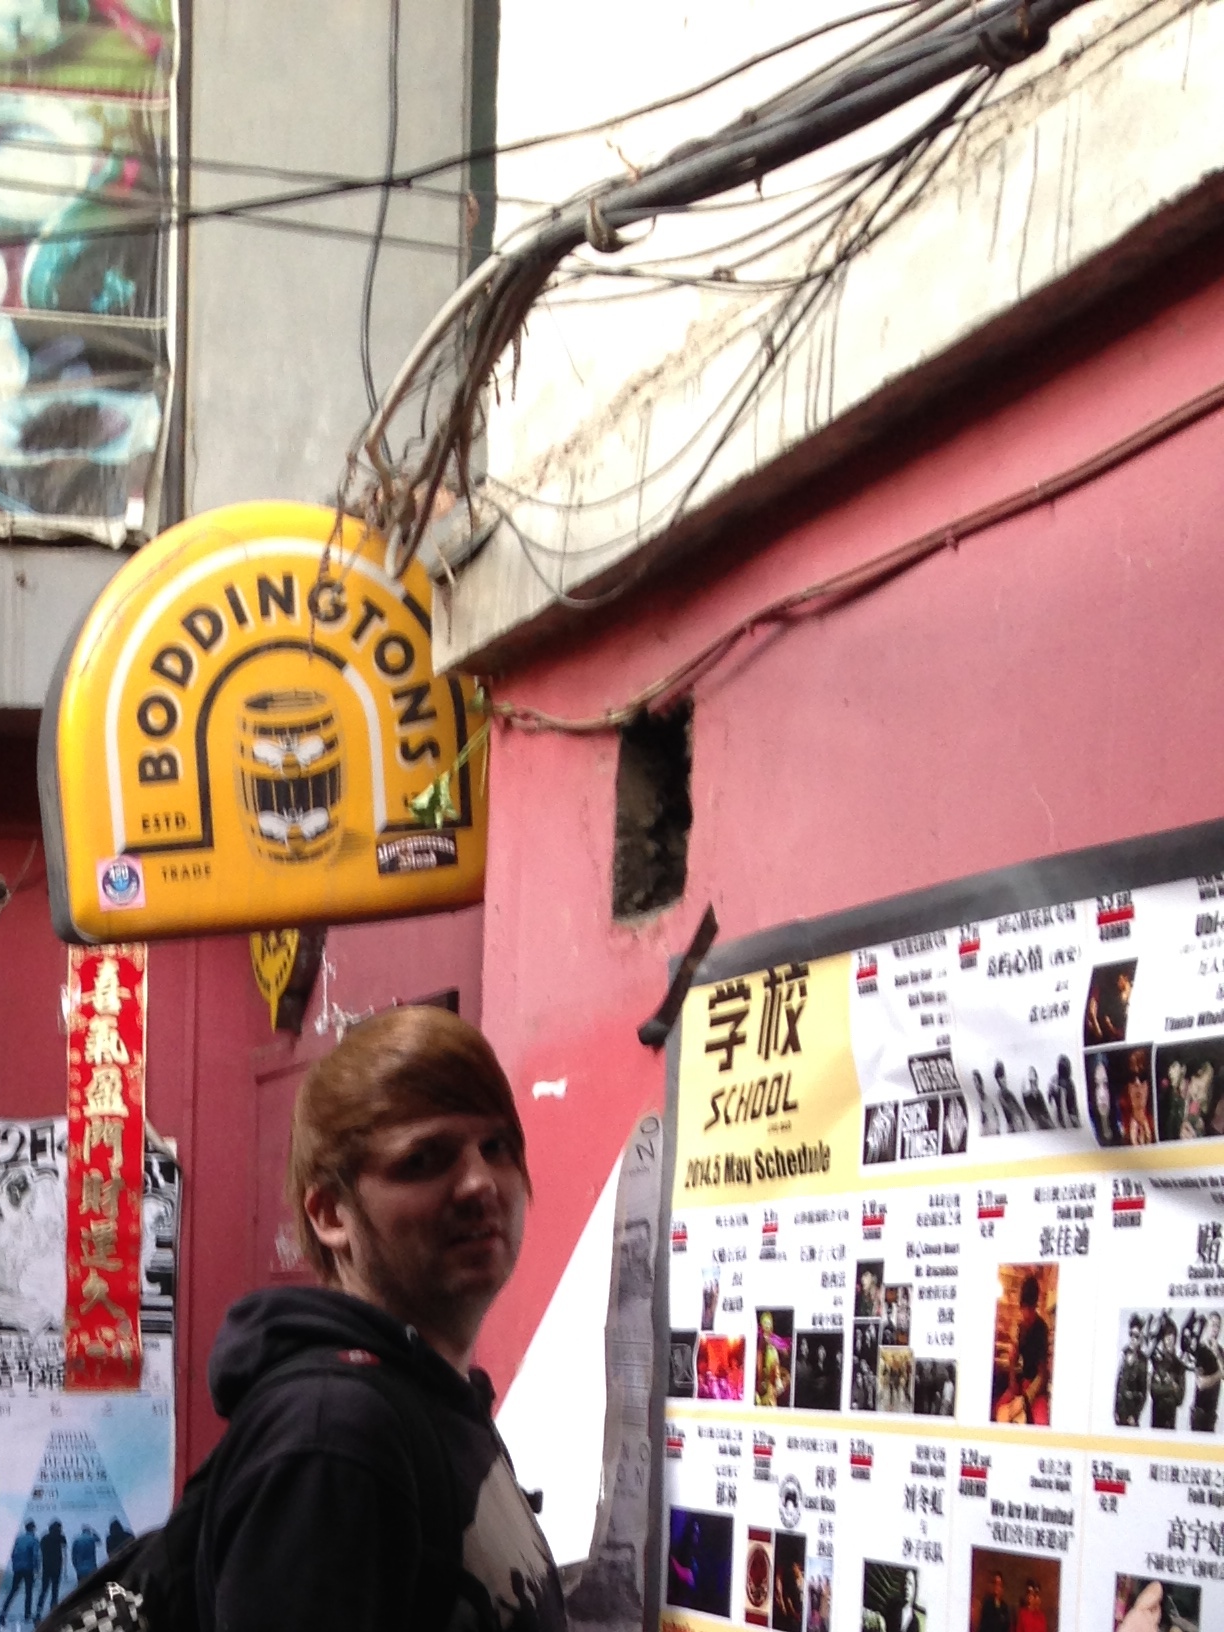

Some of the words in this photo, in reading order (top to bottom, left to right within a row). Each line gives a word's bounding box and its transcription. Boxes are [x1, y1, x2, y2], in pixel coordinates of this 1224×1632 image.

[136, 570, 441, 786] BODDINGTONS
[704, 961, 811, 1073] 学校
[704, 1069, 799, 1134] SCHOOL
[724, 1151, 753, 1186] May
[754, 1138, 831, 1182] Schedule
